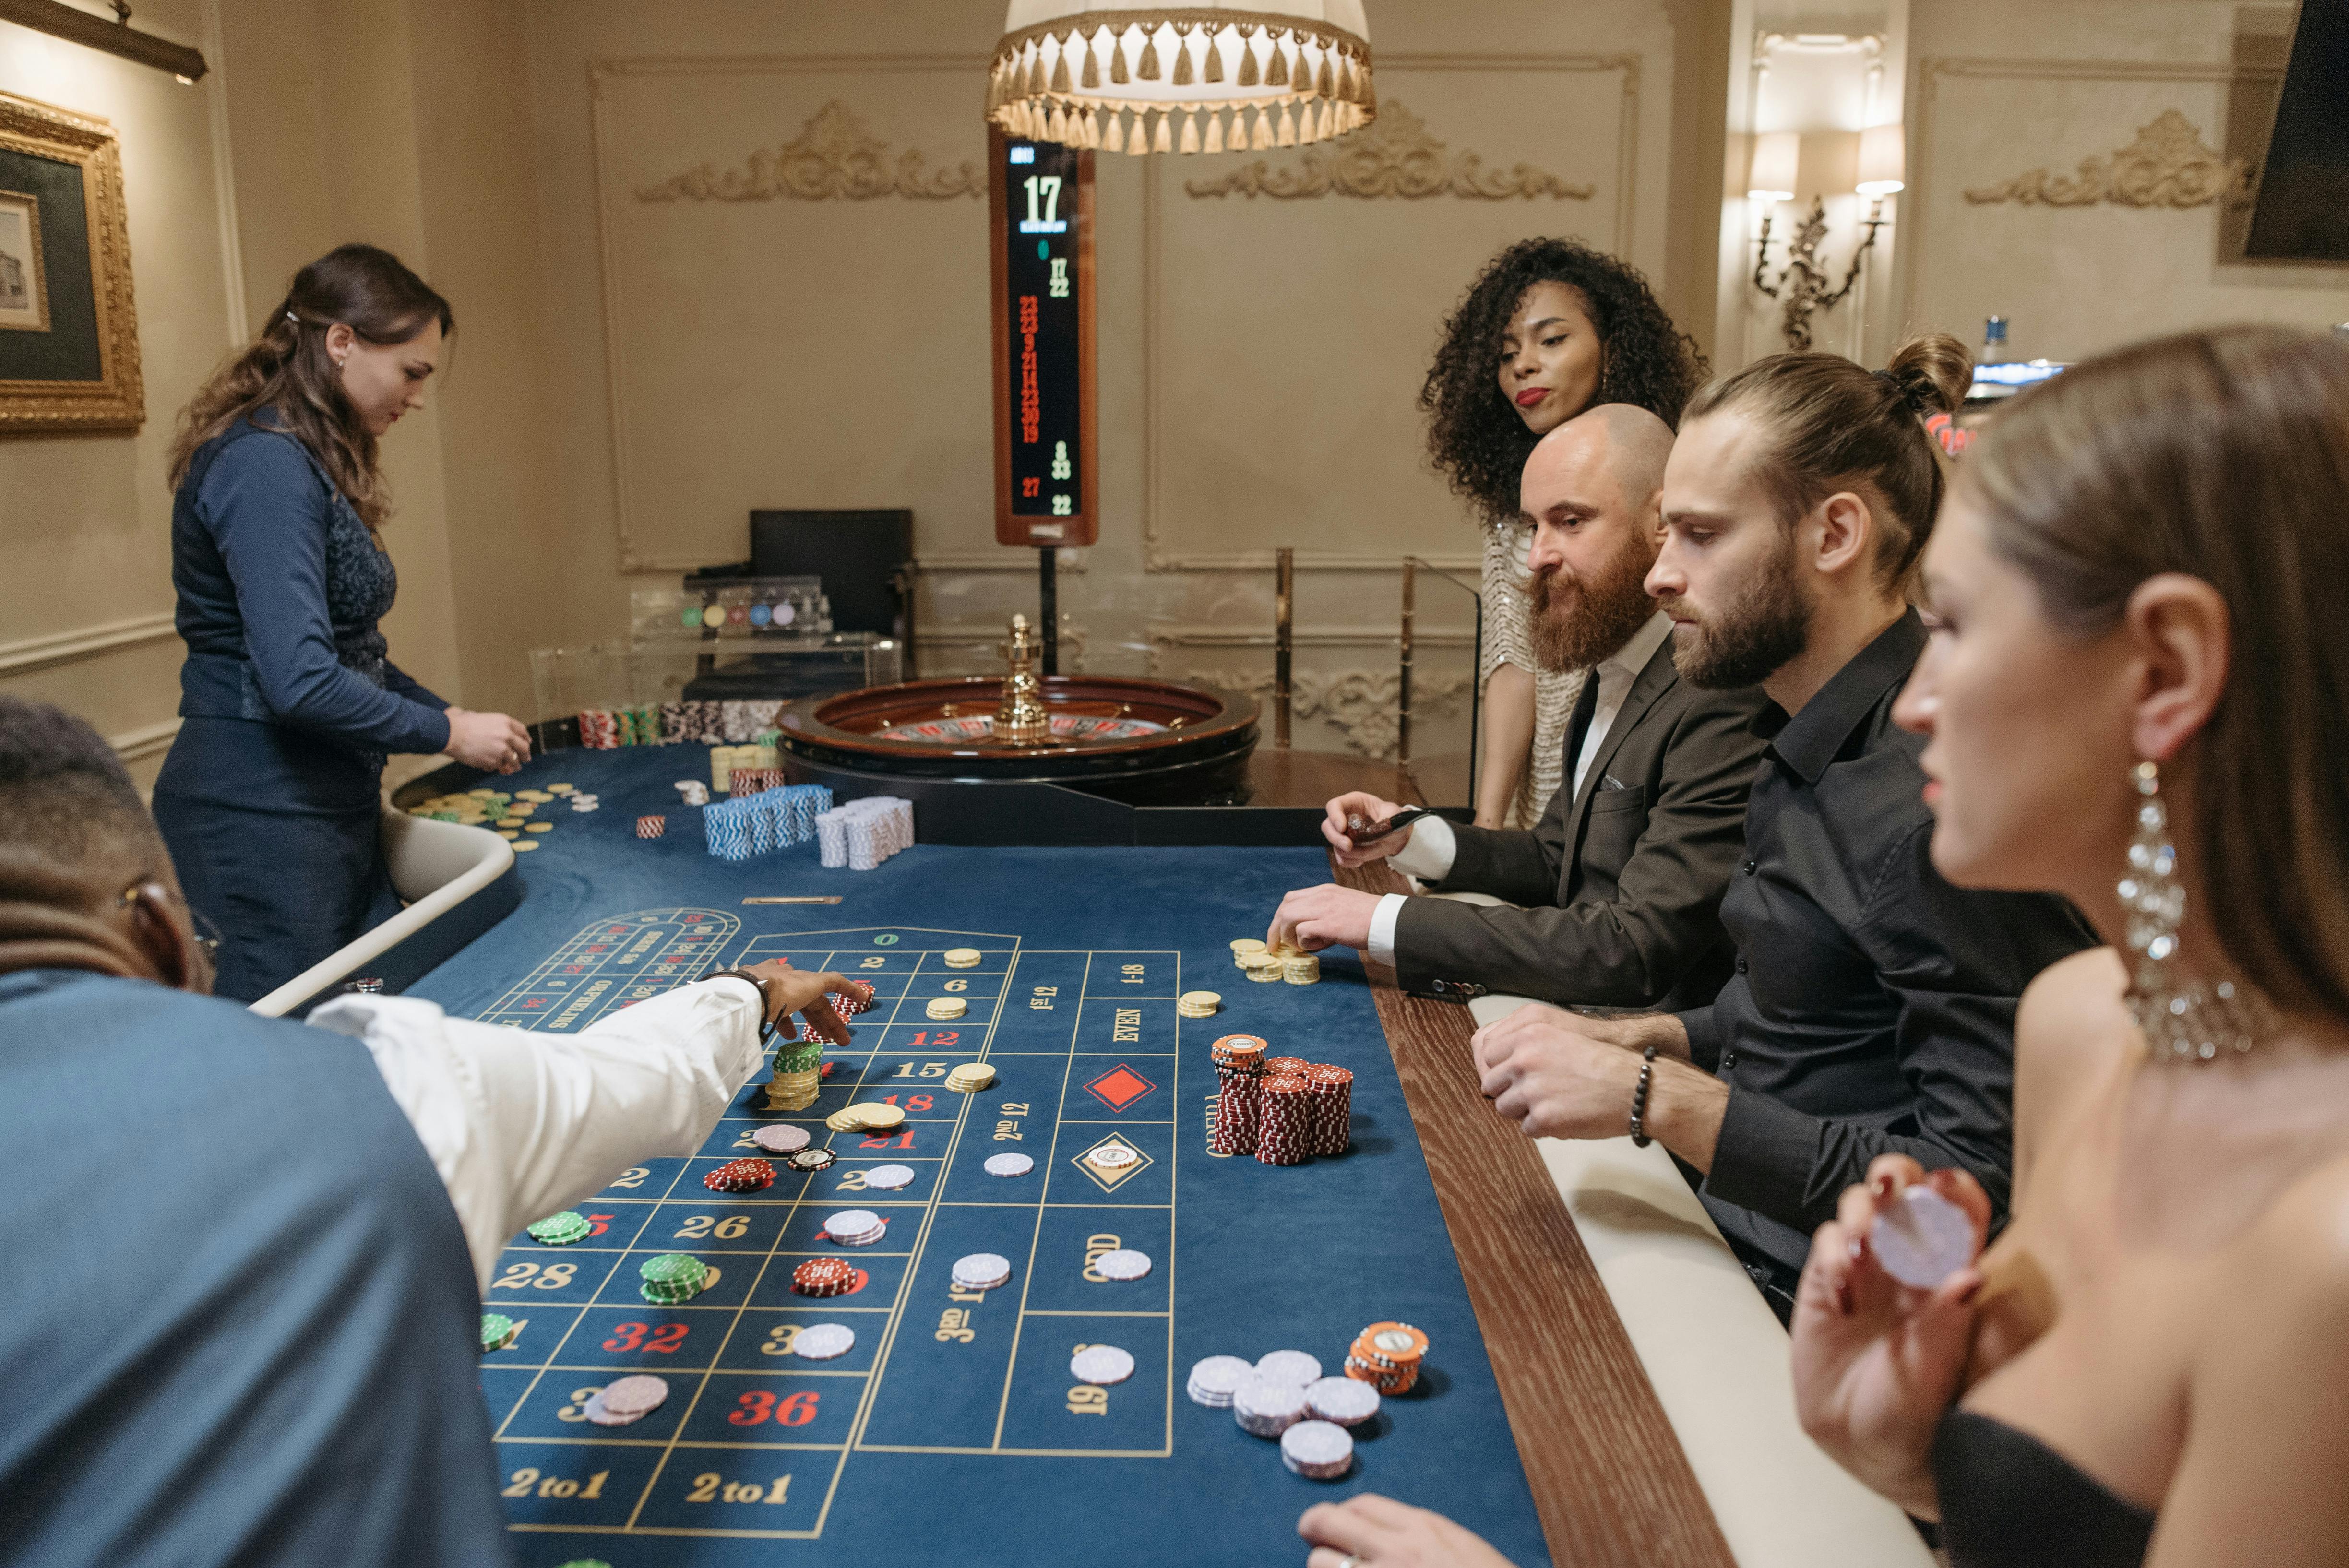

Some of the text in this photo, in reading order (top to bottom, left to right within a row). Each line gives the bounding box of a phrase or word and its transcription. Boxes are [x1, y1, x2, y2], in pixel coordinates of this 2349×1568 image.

[1024, 175, 1061, 222] 17
[1050, 258, 1067, 278] 17
[1049, 277, 1069, 297] 22
[1022, 477, 1041, 498] 27
[1052, 494, 1072, 516] 22
[874, 933, 899, 946] 0
[859, 956, 886, 969] 2
[1120, 964, 1145, 984] 1-18
[632, 986, 656, 998] 20
[943, 979, 968, 992] 6
[1029, 986, 1058, 1010] 1ST 12
[1113, 1008, 1141, 1042] EVEN
[906, 1032, 960, 1045] 12
[892, 1062, 947, 1078] 15
[883, 1094, 934, 1111] 18
[993, 1103, 1030, 1141] 2ND 12
[859, 1130, 916, 1149] 21
[673, 1215, 751, 1239] 26
[491, 1262, 579, 1290] 28
[935, 1307, 975, 1343] 3RD
[602, 1322, 690, 1354] 32
[728, 1390, 821, 1427] 36
